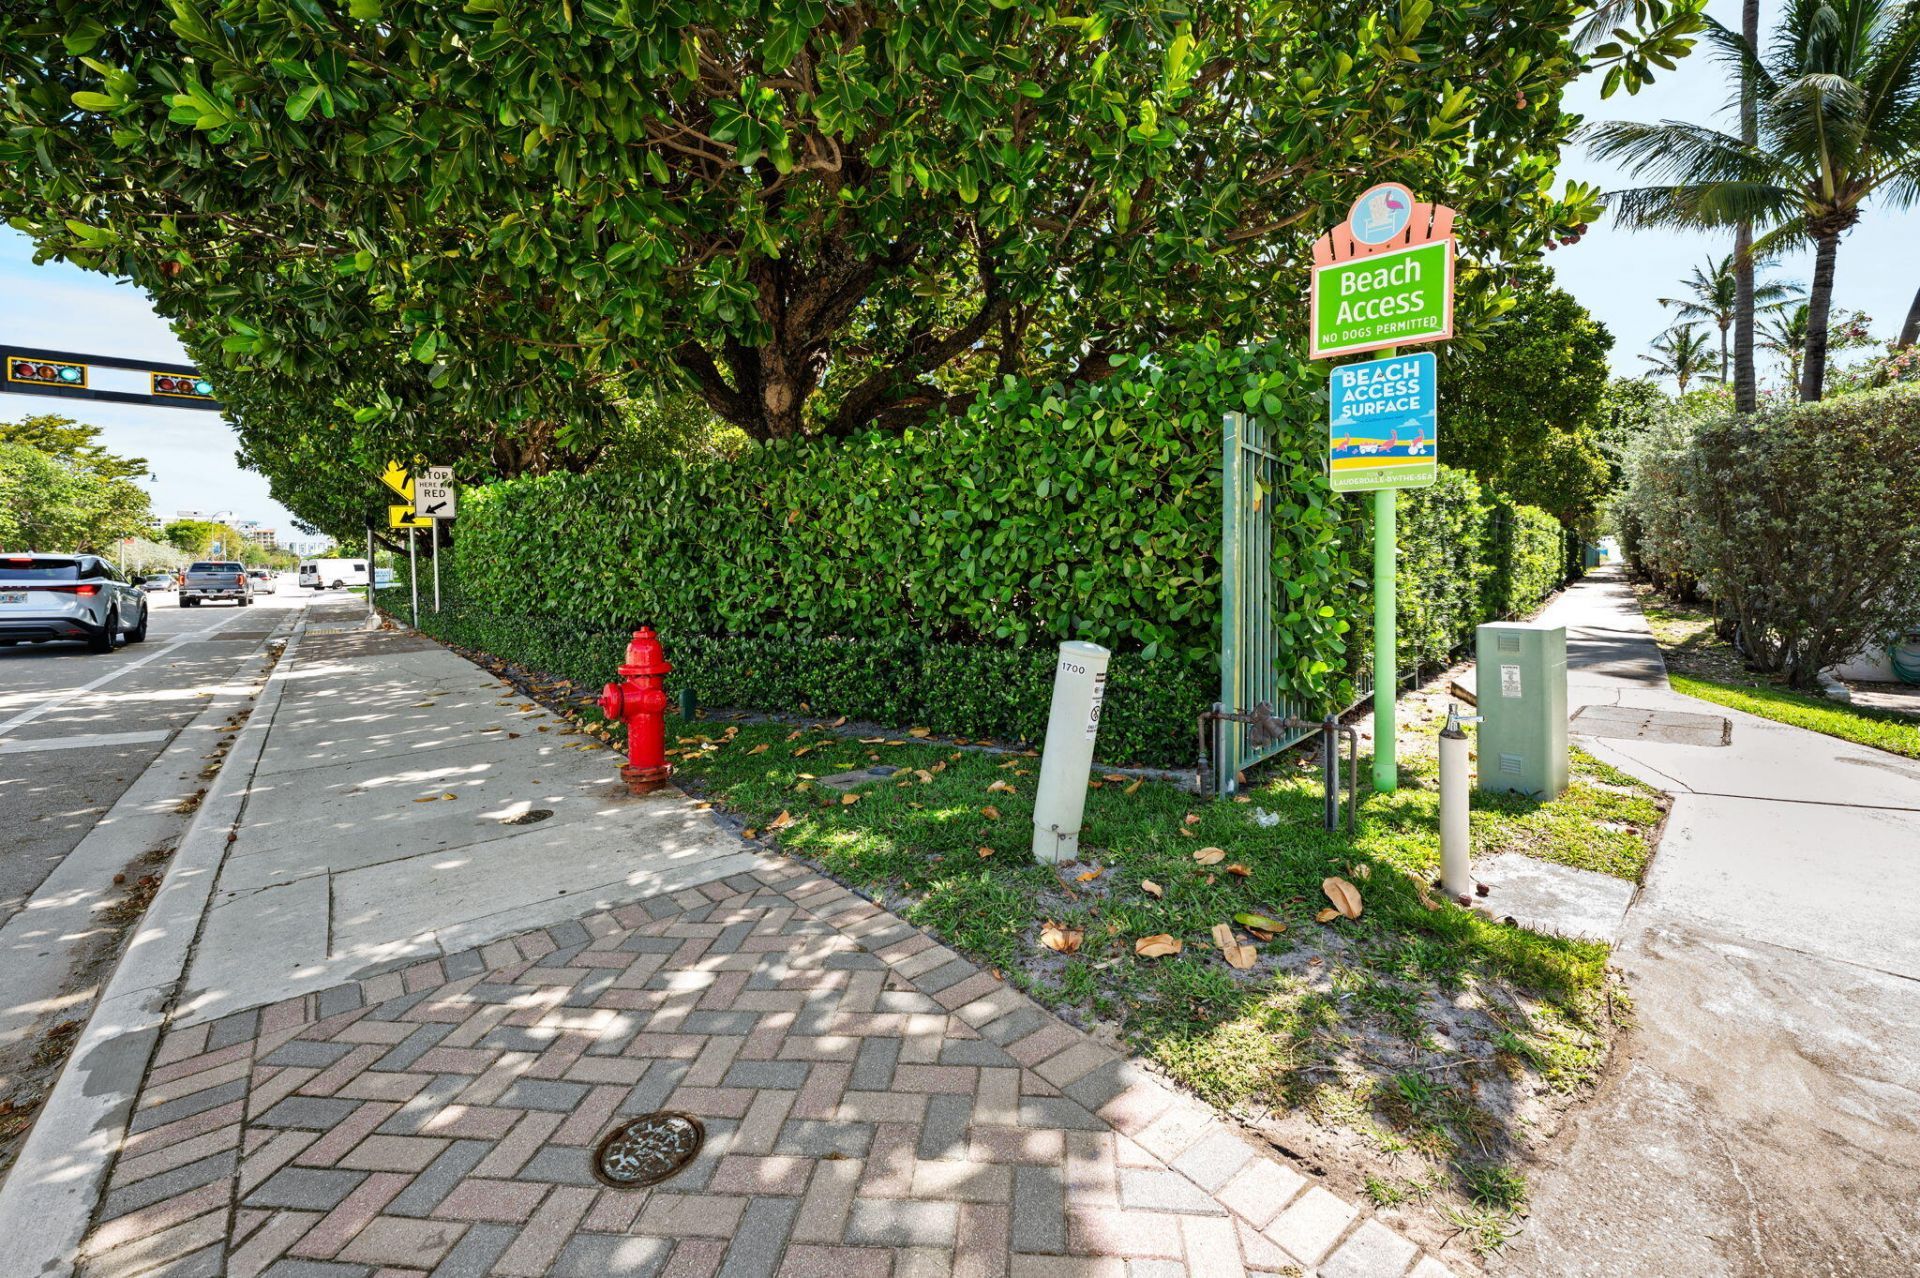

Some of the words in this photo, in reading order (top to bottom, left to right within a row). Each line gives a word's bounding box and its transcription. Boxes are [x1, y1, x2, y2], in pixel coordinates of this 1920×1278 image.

[1340, 257, 1421, 296] Beach
[1336, 290, 1424, 325] Access
[1322, 333, 1337, 343] NO
[1343, 327, 1372, 341] DOGS
[1376, 316, 1438, 335] PERMITTED
[1342, 361, 1420, 388] BEACH
[1342, 378, 1421, 402] ACCESS
[1342, 396, 1421, 418] SURFACE
[424, 489, 446, 497] RED
[1062, 662, 1085, 674] 1700
